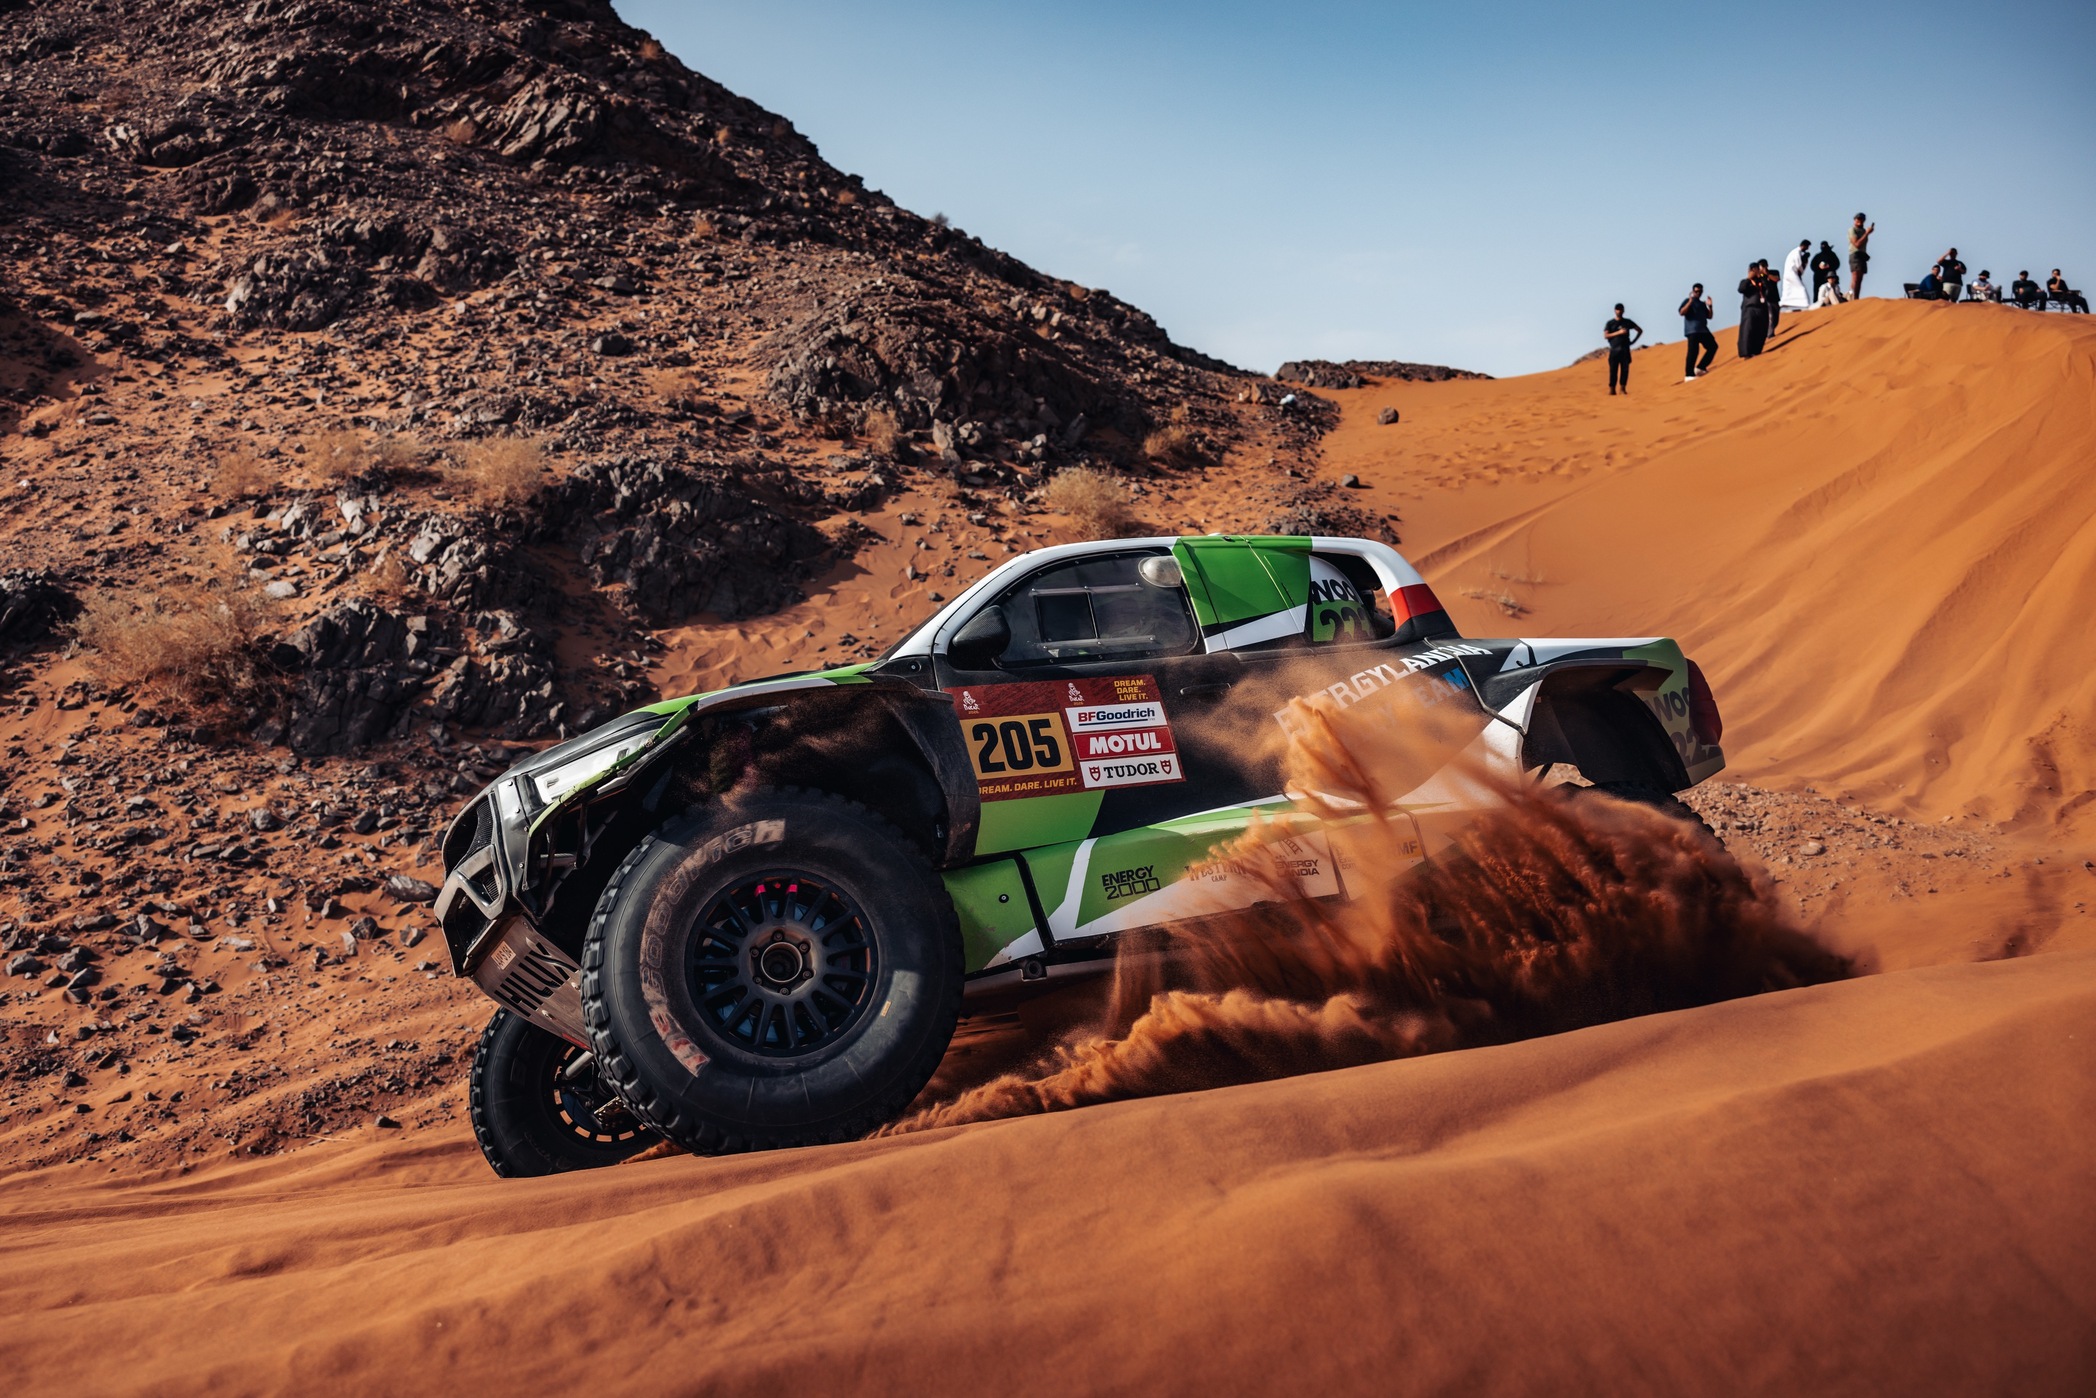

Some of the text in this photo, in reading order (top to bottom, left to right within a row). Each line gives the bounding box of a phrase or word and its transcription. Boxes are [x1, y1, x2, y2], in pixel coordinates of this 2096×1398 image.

[1114, 679, 1146, 687] DREAM.
[1117, 686, 1141, 694] DARE.
[1412, 667, 1470, 709] EAM
[1273, 644, 1493, 746] ERGYLANDIA
[1078, 708, 1155, 722] BFGoodrich
[972, 719, 1061, 773] 205
[1089, 732, 1162, 755] MOTUL
[1103, 762, 1159, 778] TUDOR
[1014, 781, 1042, 791] DARE.
[1044, 779, 1065, 788] LIVE
[1066, 778, 1077, 786] IT.
[1275, 859, 1319, 868] ENERGY
[1102, 865, 1154, 886] ENERGY
[1105, 877, 1161, 900] 2000
[494, 942, 579, 1018] HILUX
